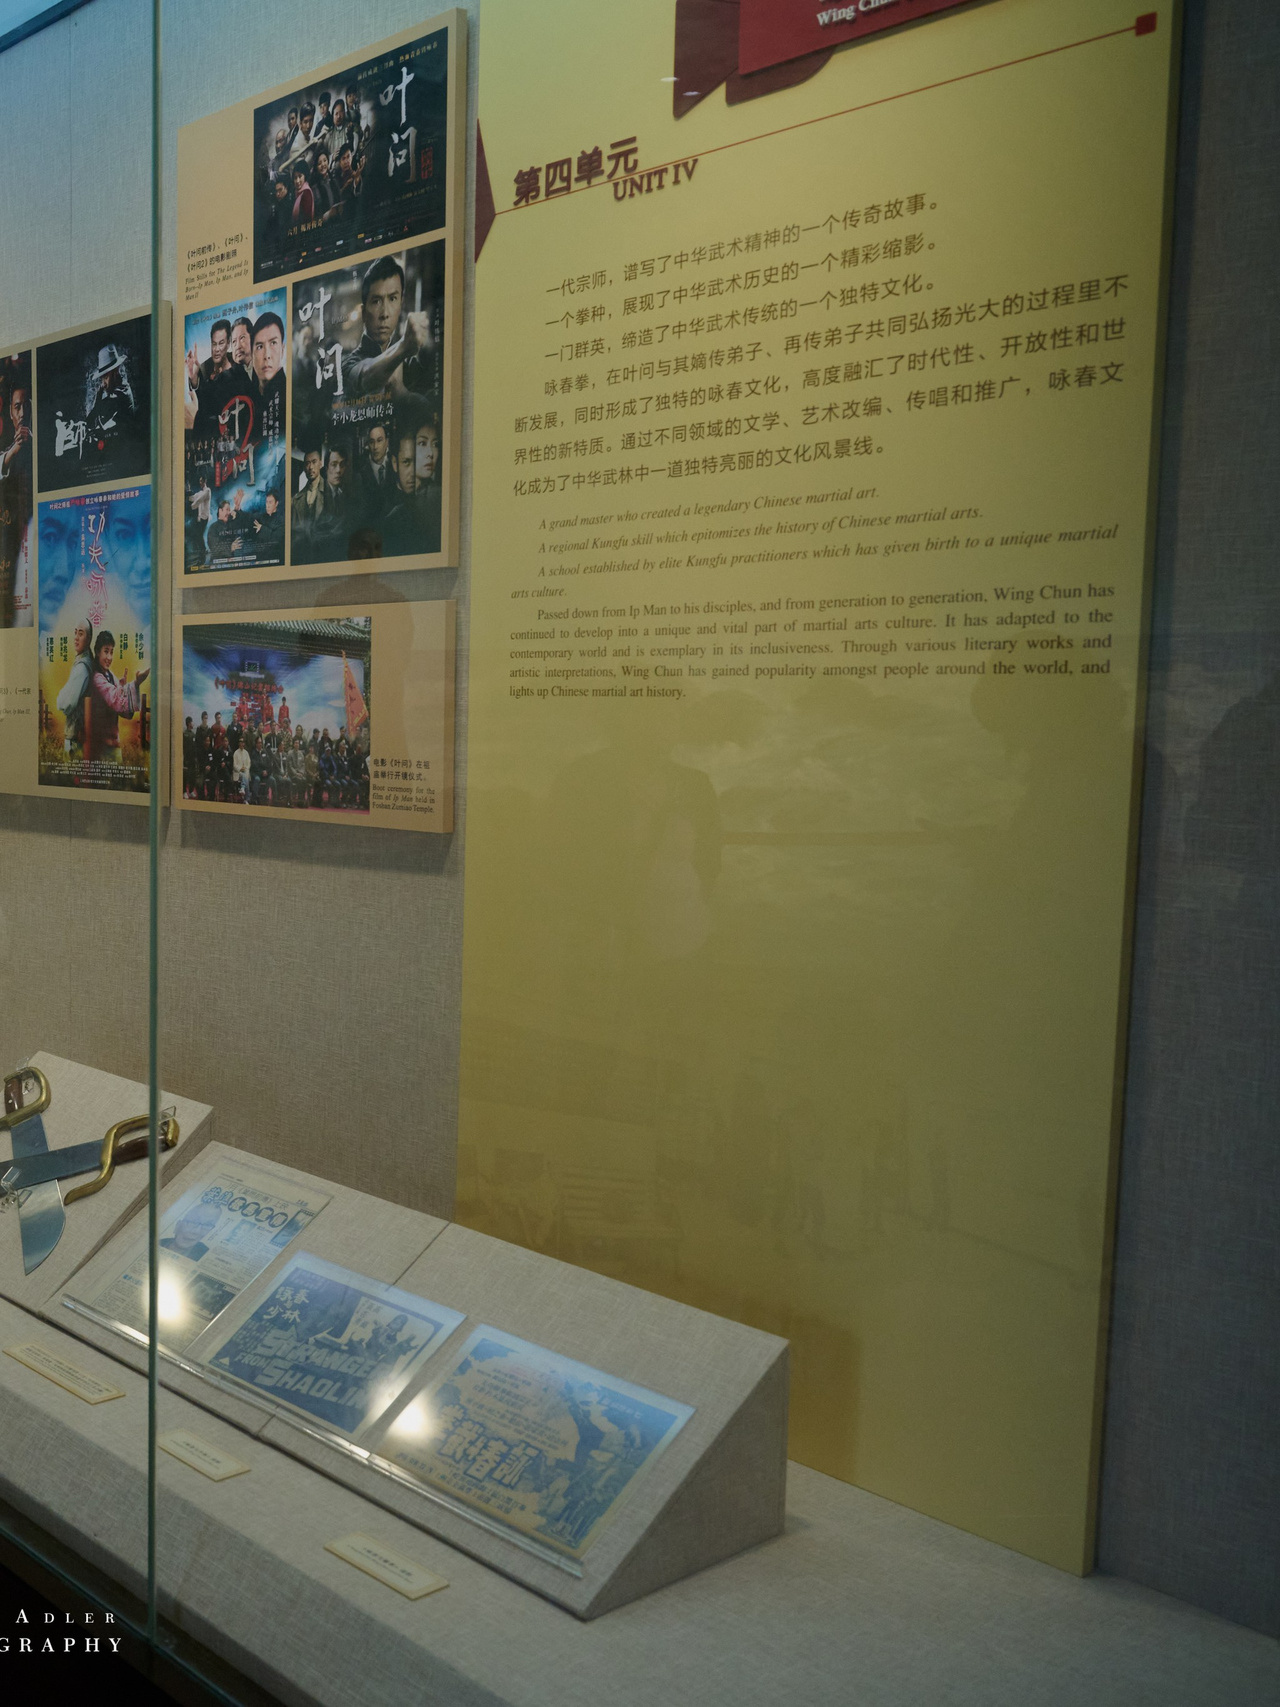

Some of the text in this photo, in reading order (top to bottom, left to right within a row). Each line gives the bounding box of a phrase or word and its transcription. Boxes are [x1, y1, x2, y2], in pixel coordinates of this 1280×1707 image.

[816, 5, 857, 26] Wing
[513, 136, 638, 206] 第四单元
[612, 159, 699, 202] UNIT IV
[545, 193, 938, 297] 一代宗师，谱写了中华武术精神的一个传奇故事。
[545, 232, 936, 329] 一个拳种，展现了中华武术历史的一个精彩缩影。
[544, 272, 934, 363] 一门群英，缔造了中华武术传统的一个独特文化。
[544, 273, 1130, 397] 咏春拳，在叶问与其嫡传弟子、再传弟子共同弘扬光大的过程里不
[514, 316, 1126, 433] 断发展，同时形成了独特的咏春文化，高度融汇了时代性、开放性和世
[513, 361, 1125, 466] 界性的新特质。通过不同领域的文学、艺术改编、传唱和推广，咏春文
[513, 436, 884, 497] 化成为了中华武林中一道独特亮丽的文化风景线。
[539, 486, 880, 532] A grand master who created a legendary Chinese martial art.
[539, 507, 983, 554] A regional Kungfu skill which epitomizes the history of Chinese martial arts.
[538, 524, 1119, 577] A school established by elite Kungfu practitioners which has given birth to a unique martial
[511, 586, 568, 599] arts culture.
[537, 583, 1115, 621] Passed down from Ip Man to his disciples, and from generation to generation, Wing Chun has
[510, 634, 1112, 661] contemporary world and is exemplary in its inclusiveness. Through various literary works and
[510, 684, 686, 700] lights up Chinese martial art history.
[234, 1351, 271, 1371] FROM
